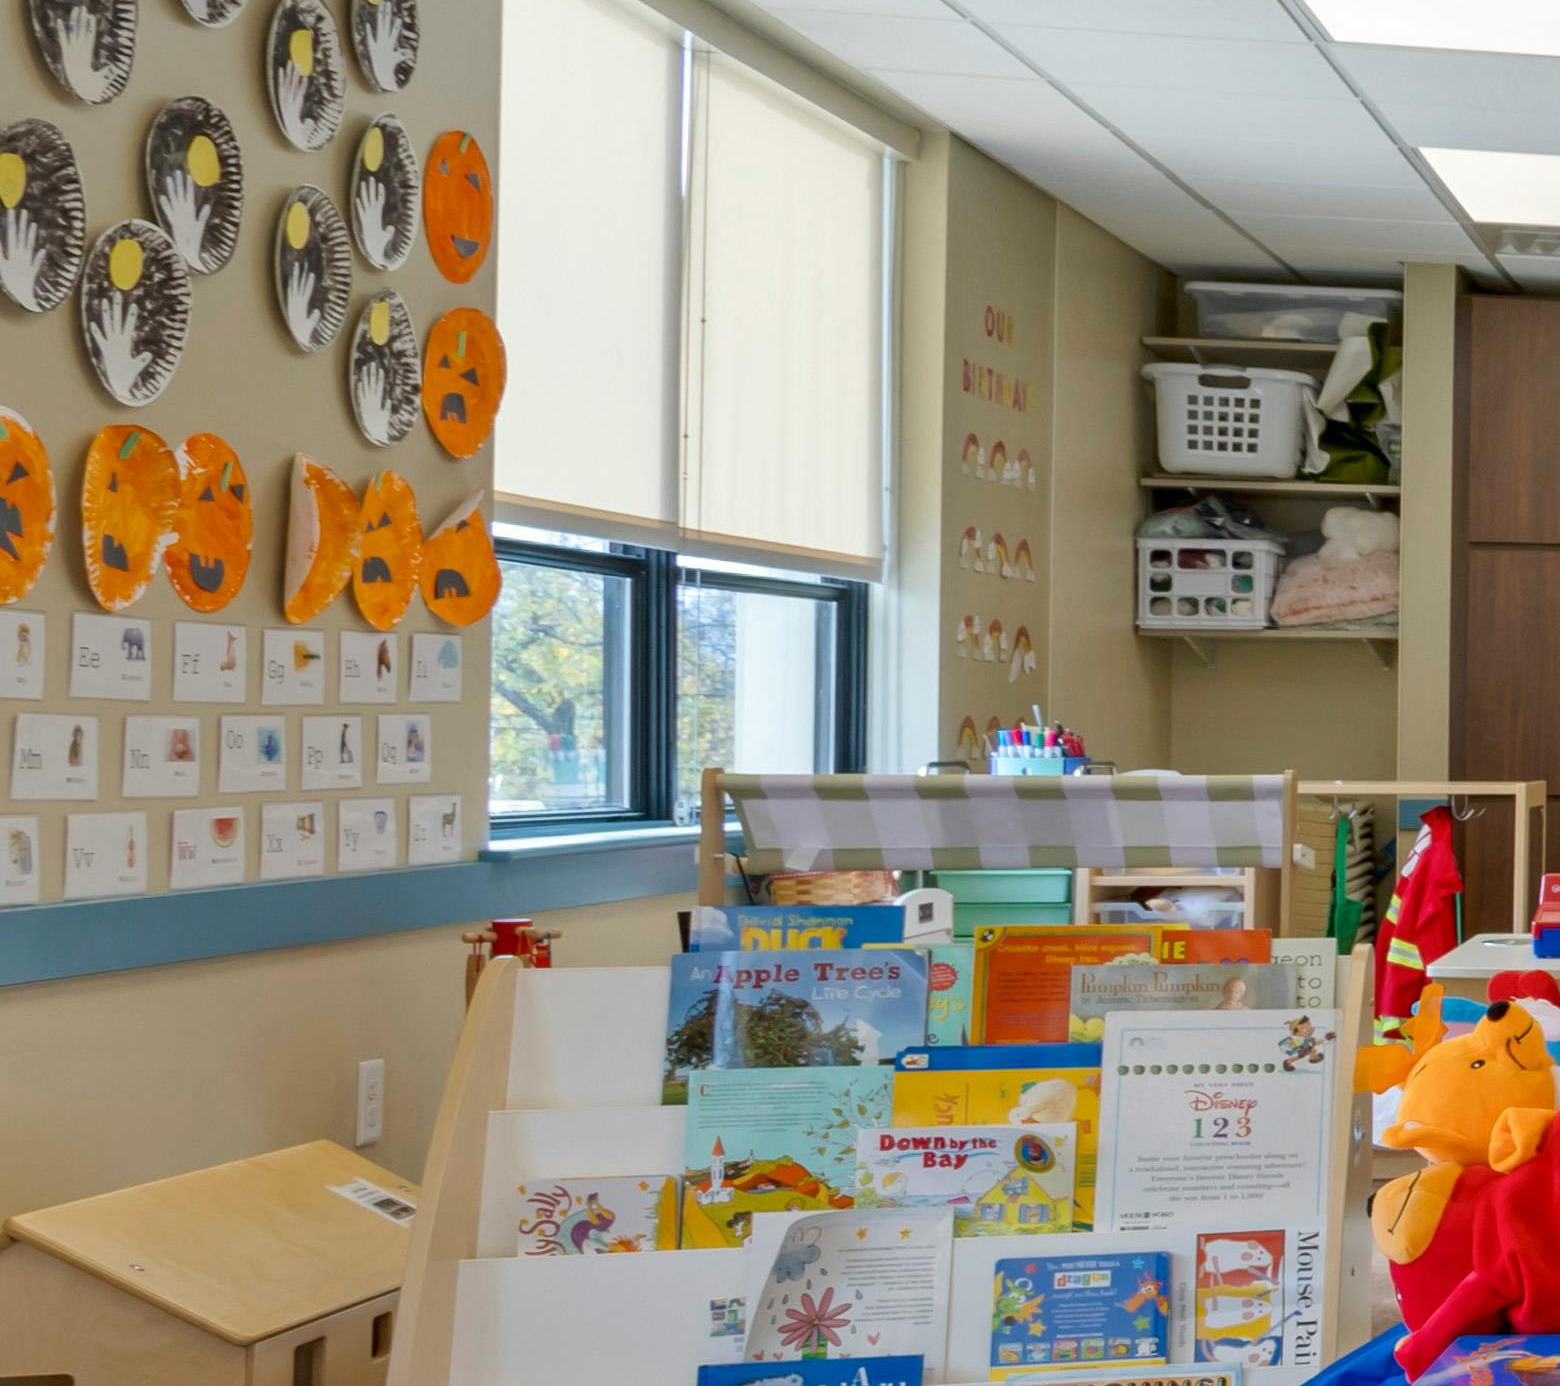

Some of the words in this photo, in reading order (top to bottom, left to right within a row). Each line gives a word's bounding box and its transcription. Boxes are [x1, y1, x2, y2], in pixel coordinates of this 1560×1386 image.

[689, 967, 712, 981] An
[713, 965, 800, 990] Apple
[814, 963, 901, 982] Tree's
[1081, 972, 1148, 995] Pumpkin
[1152, 972, 1220, 994] Pumpkin
[855, 985, 901, 1001] Cycle
[1194, 1118, 1203, 1139] 1
[1213, 1117, 1229, 1138] 2
[1235, 1116, 1252, 1138] 3
[880, 1134, 946, 1151] Down
[950, 1138, 967, 1151] by
[971, 1138, 997, 1149] the
[923, 1152, 968, 1170] Bay
[519, 1185, 572, 1237] Sally
[1295, 1231, 1320, 1308] Mouse
[852, 1367, 869, 1386] A
